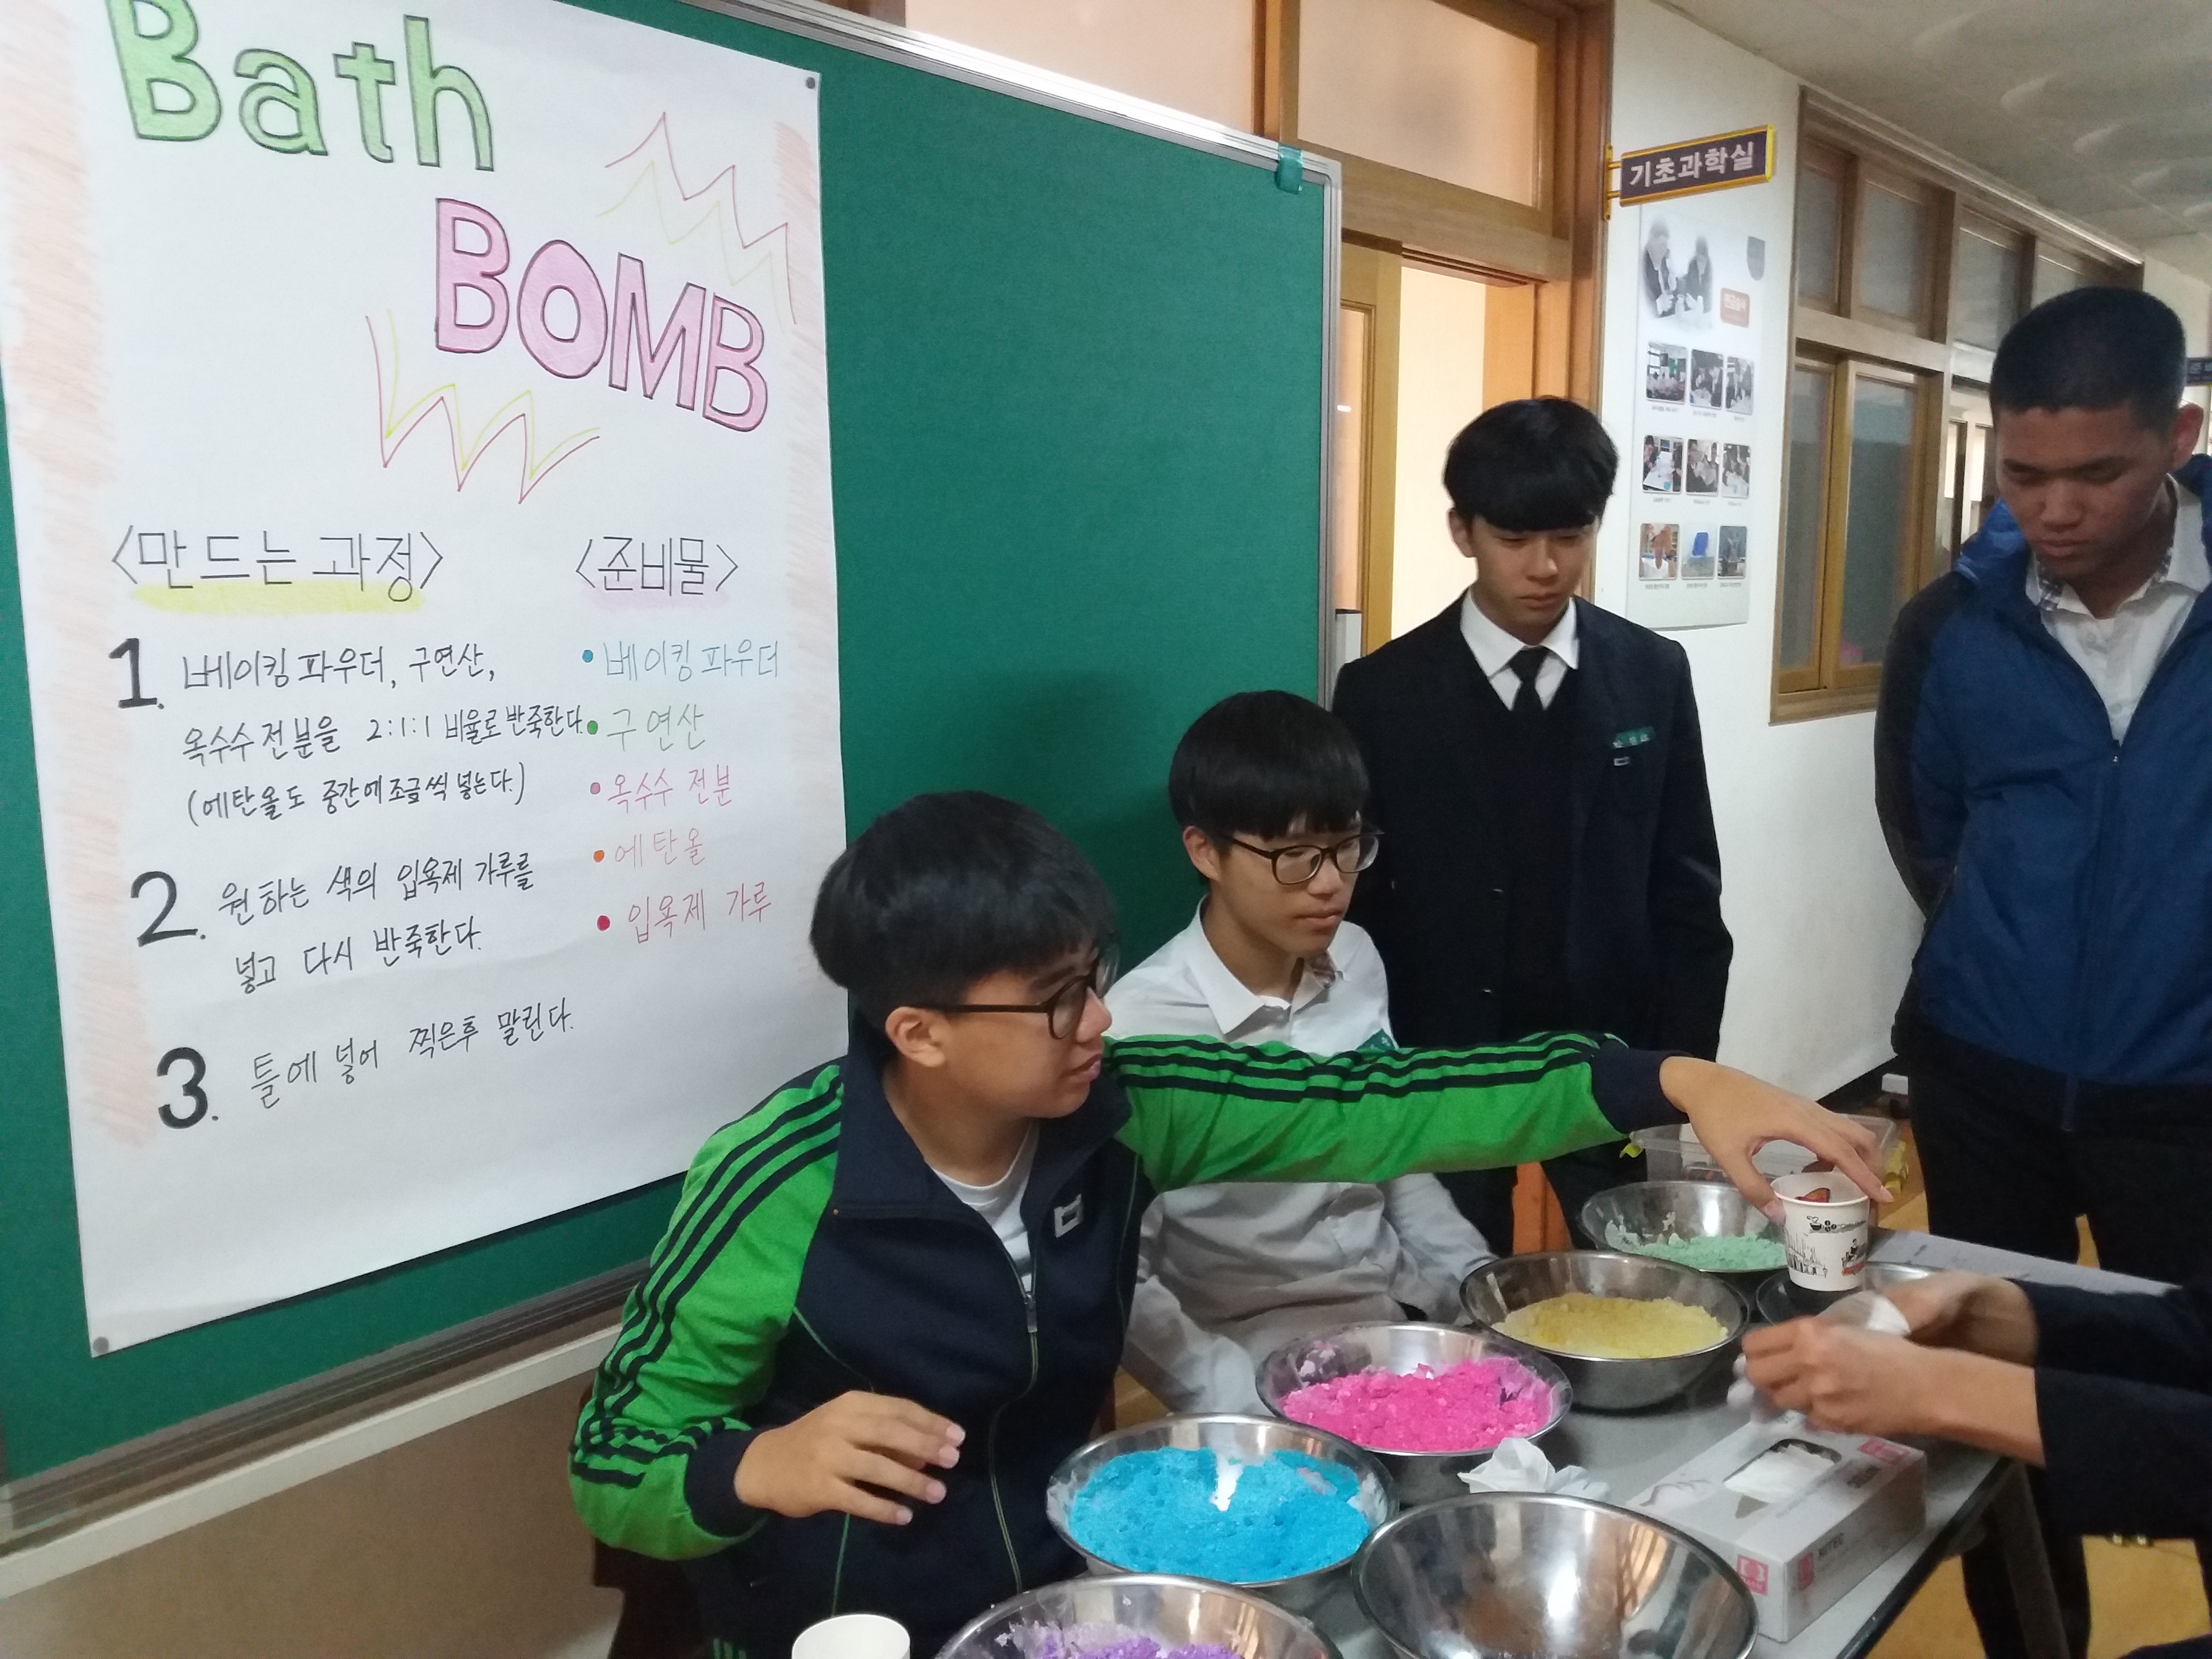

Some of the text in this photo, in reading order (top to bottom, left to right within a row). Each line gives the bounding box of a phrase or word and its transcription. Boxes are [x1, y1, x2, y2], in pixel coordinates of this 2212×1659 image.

[107, 0, 495, 171] Bath
[1629, 141, 1755, 188] 기초과학실
[434, 197, 768, 432] BOMB
[409, 642, 495, 683] 구연산,
[367, 714, 430, 743] 2:1:1
[607, 703, 706, 751] 구연산
[608, 764, 733, 813] 옥수수 전분
[615, 827, 706, 868] 에탄올
[218, 877, 310, 926] 원하는
[326, 862, 377, 902] 색의
[396, 857, 463, 902] 입욕제
[475, 851, 535, 893] 가루를
[628, 880, 772, 944] 입욕제 가루
[235, 915, 482, 995] 넣고 다시 반죽한다.
[251, 1050, 318, 1109] 틀에
[335, 1037, 379, 1085] 넣어
[497, 997, 576, 1047] 말린다.
